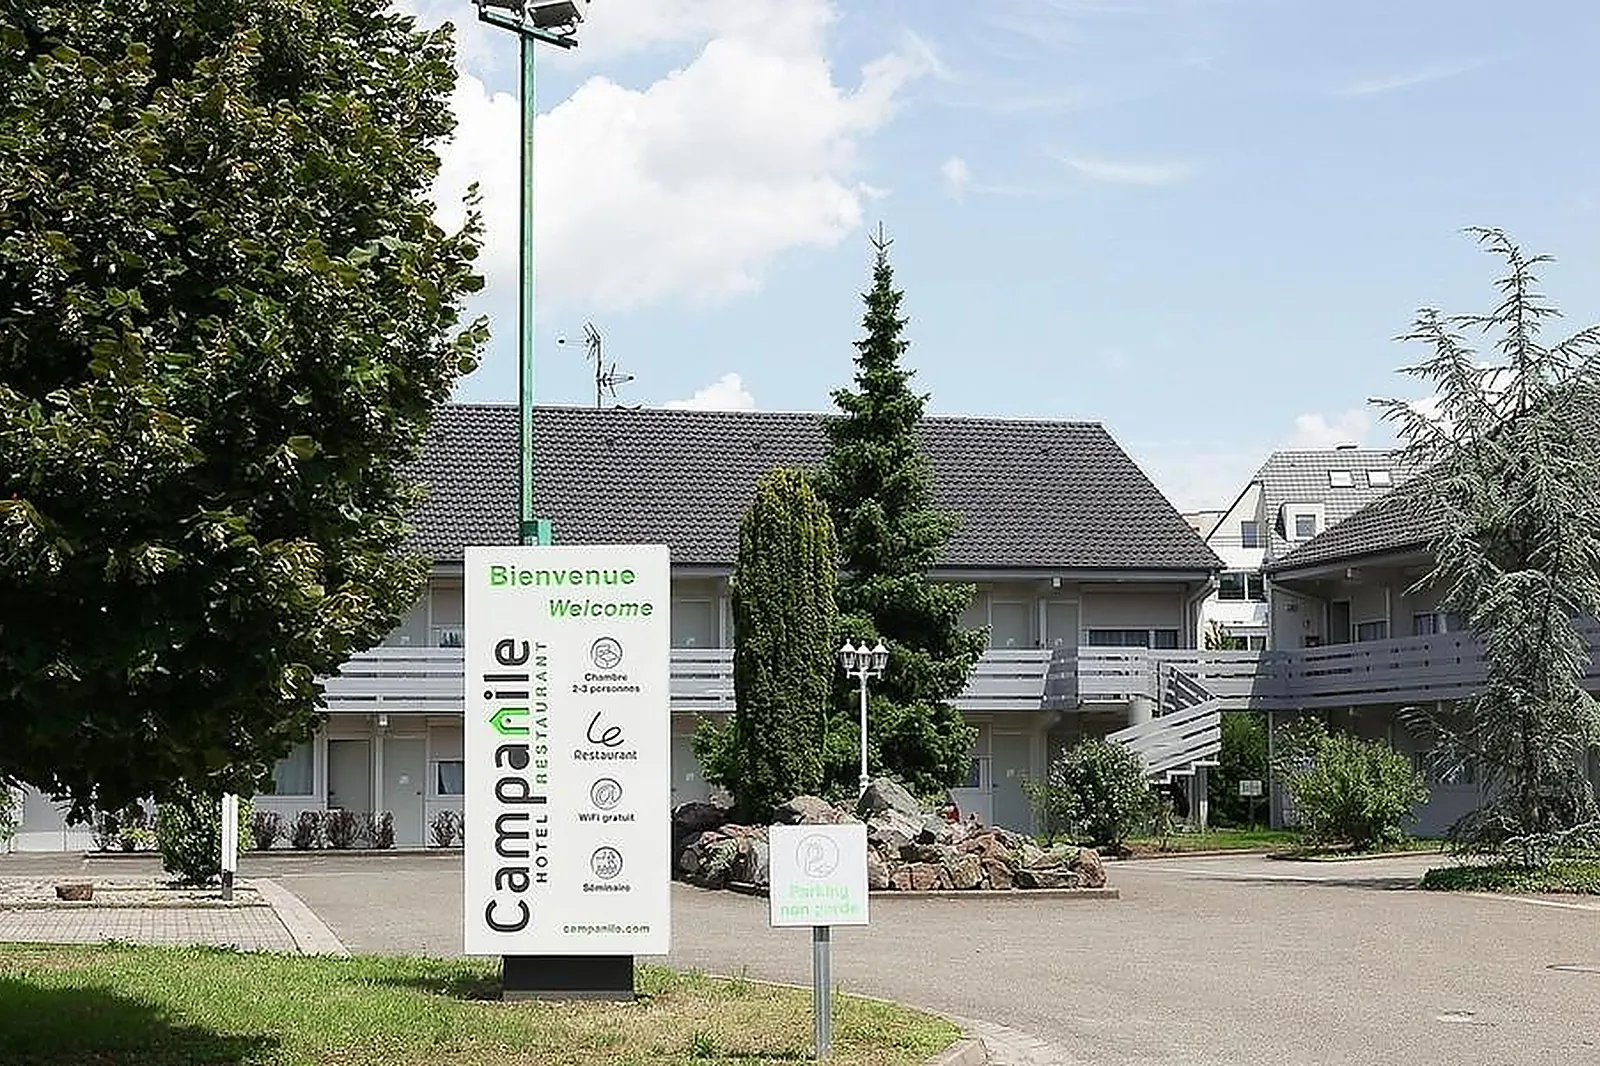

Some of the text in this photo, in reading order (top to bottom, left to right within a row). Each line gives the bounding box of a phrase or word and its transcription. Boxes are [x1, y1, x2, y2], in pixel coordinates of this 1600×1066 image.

[490, 565, 637, 587] Bienvenue
[549, 598, 654, 618] Welcome
[584, 672, 628, 682] Chambre
[572, 685, 640, 694] 2-3 personnes
[573, 750, 638, 761] Restaurant
[535, 641, 549, 884] HOTEL RESTAURANT
[483, 637, 547, 933] Campanile
[602, 813, 635, 824] gratuit
[789, 884, 849, 900] Parking
[781, 905, 809, 917] non
[563, 923, 650, 935] campanile.com
